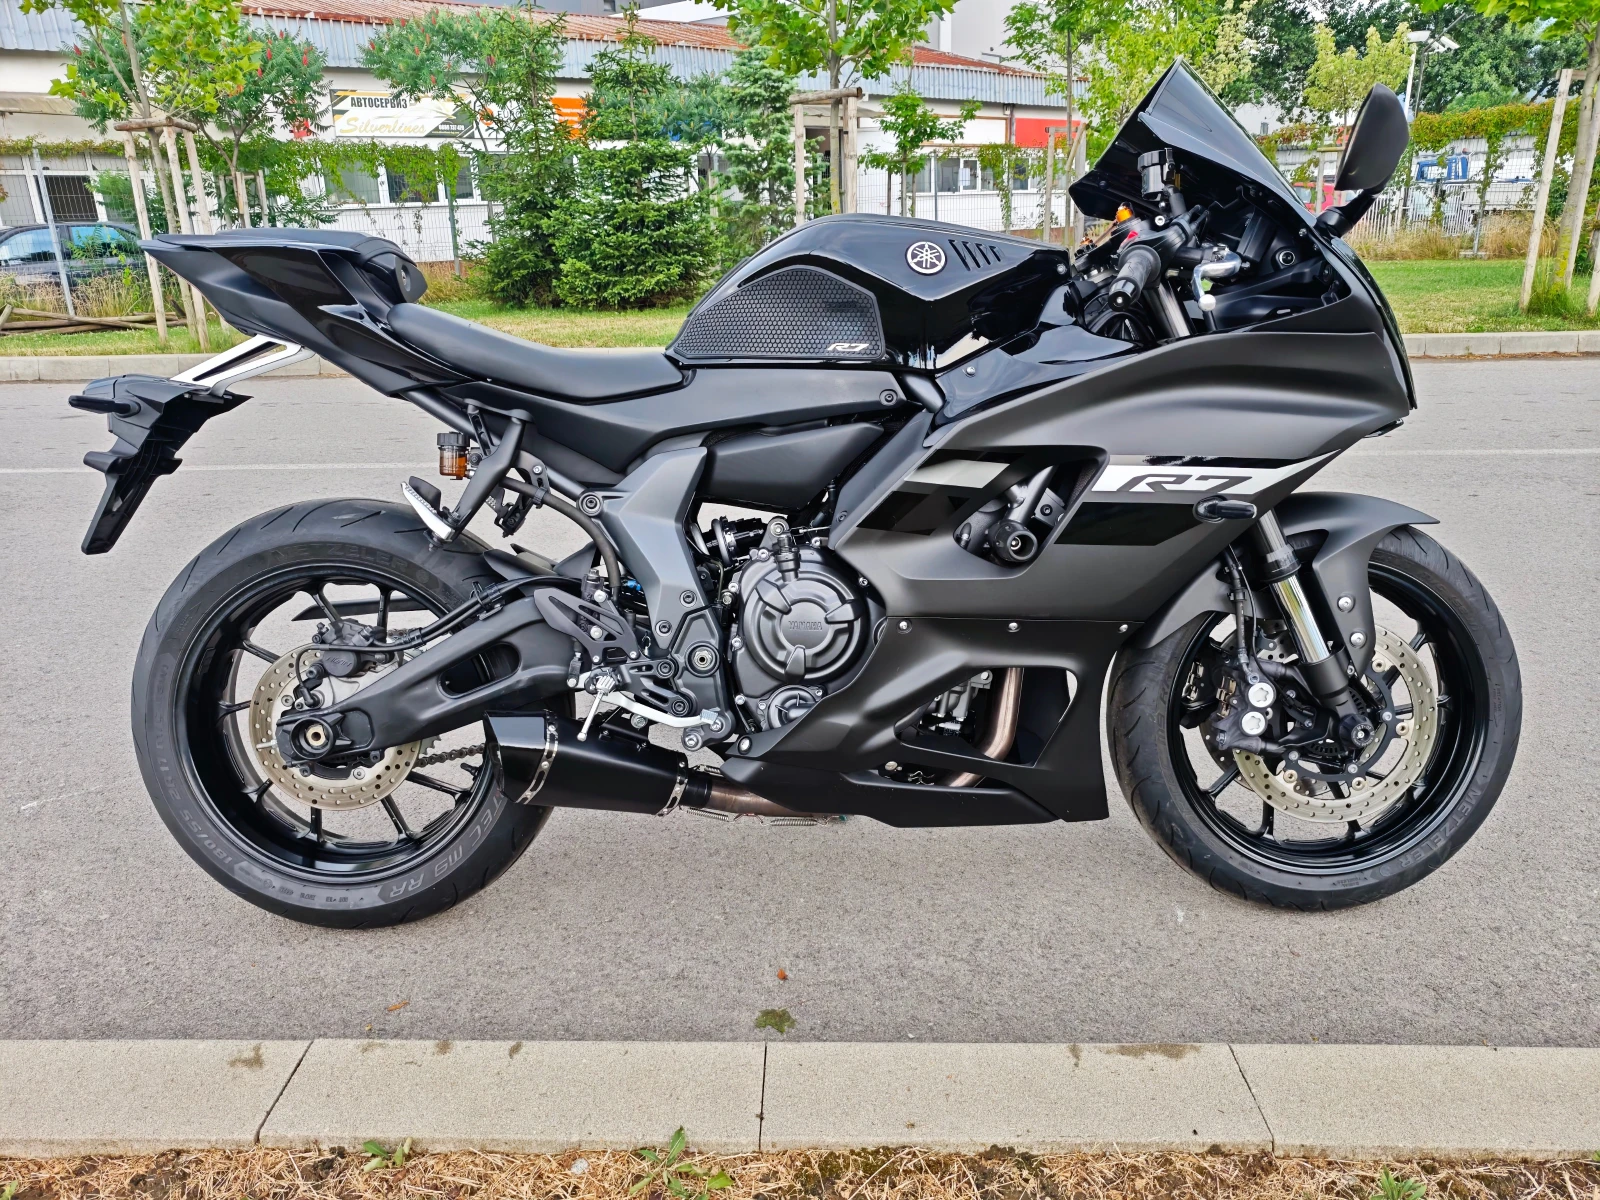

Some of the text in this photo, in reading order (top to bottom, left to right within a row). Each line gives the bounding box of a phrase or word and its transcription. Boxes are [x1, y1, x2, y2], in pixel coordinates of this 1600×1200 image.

[350, 96, 408, 109] АВТОСЕРВИЗ
[339, 117, 427, 135] Silverlines
[827, 342, 870, 352] R7
[1116, 473, 1253, 494] R7
[1400, 787, 1482, 868] METZELER
[433, 844, 464, 879] M9
[389, 872, 426, 899] RR
